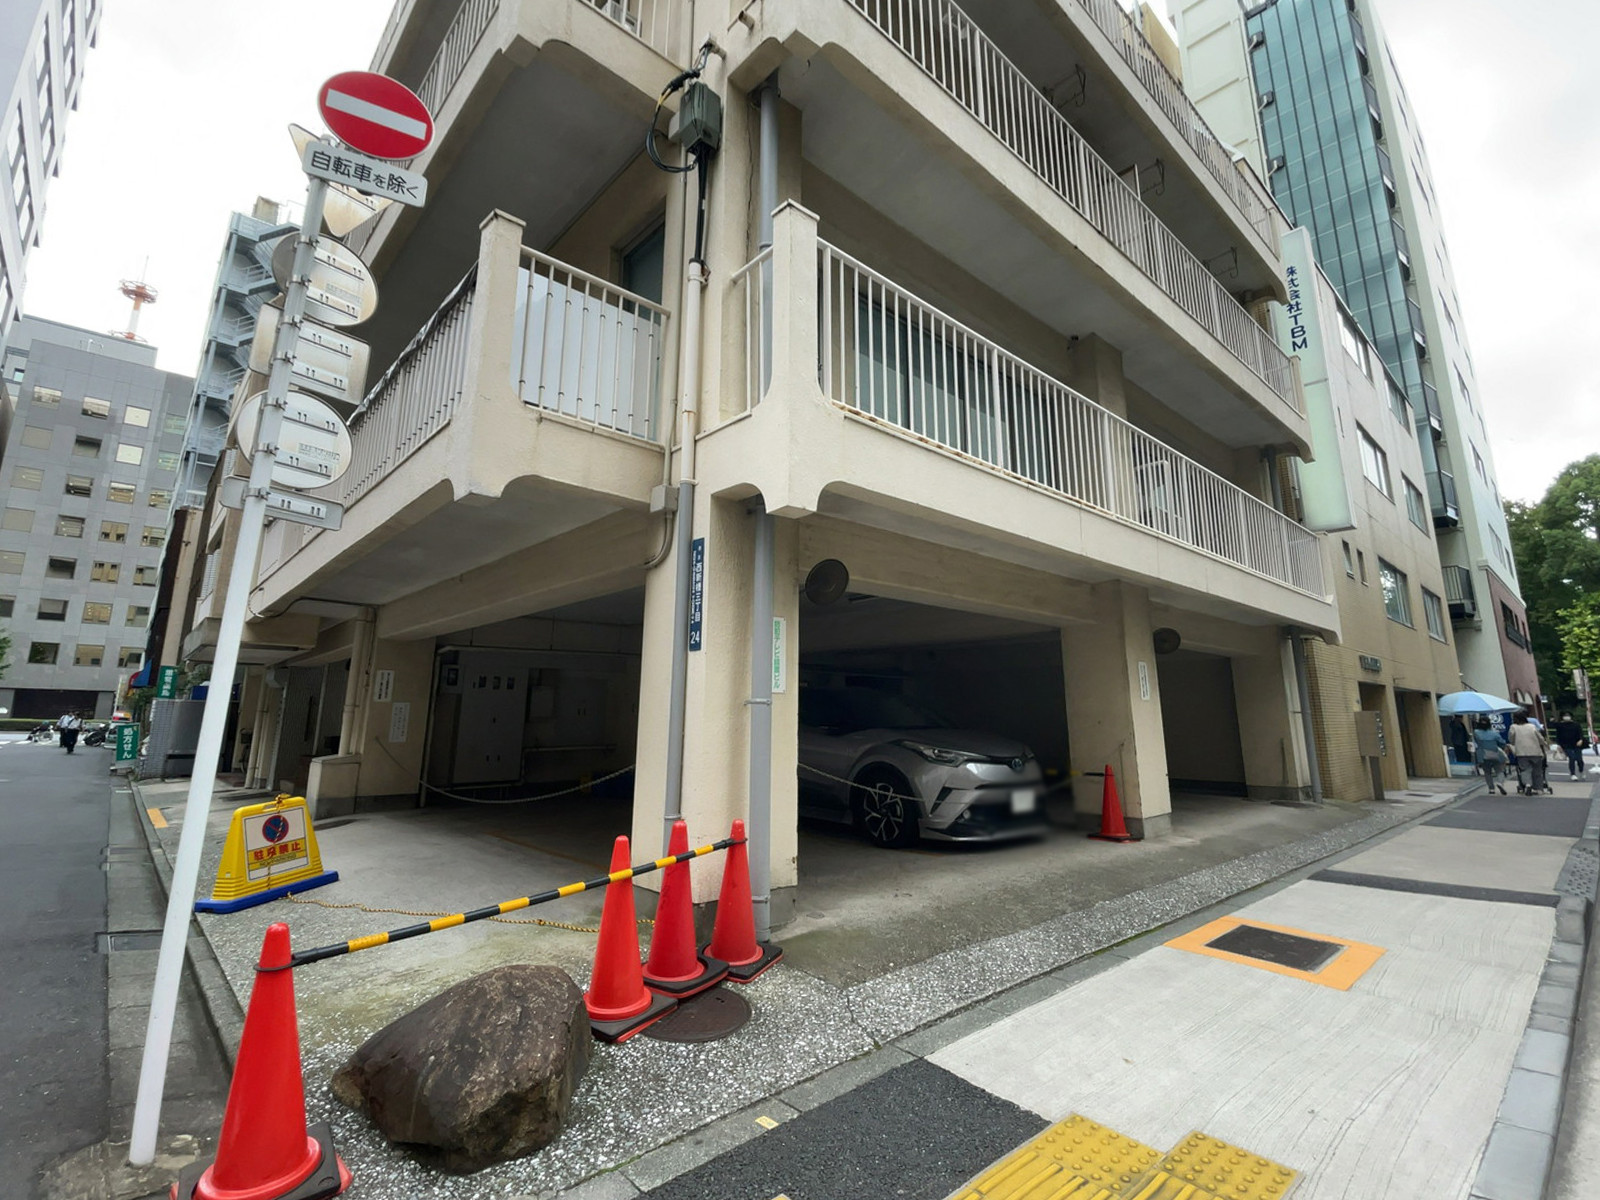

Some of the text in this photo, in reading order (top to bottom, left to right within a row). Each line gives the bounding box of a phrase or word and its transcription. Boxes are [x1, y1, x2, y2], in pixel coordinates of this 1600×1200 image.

[312, 151, 419, 199] 自転車を除く
[690, 631, 700, 644] 24
[123, 728, 134, 759] 処方せん
